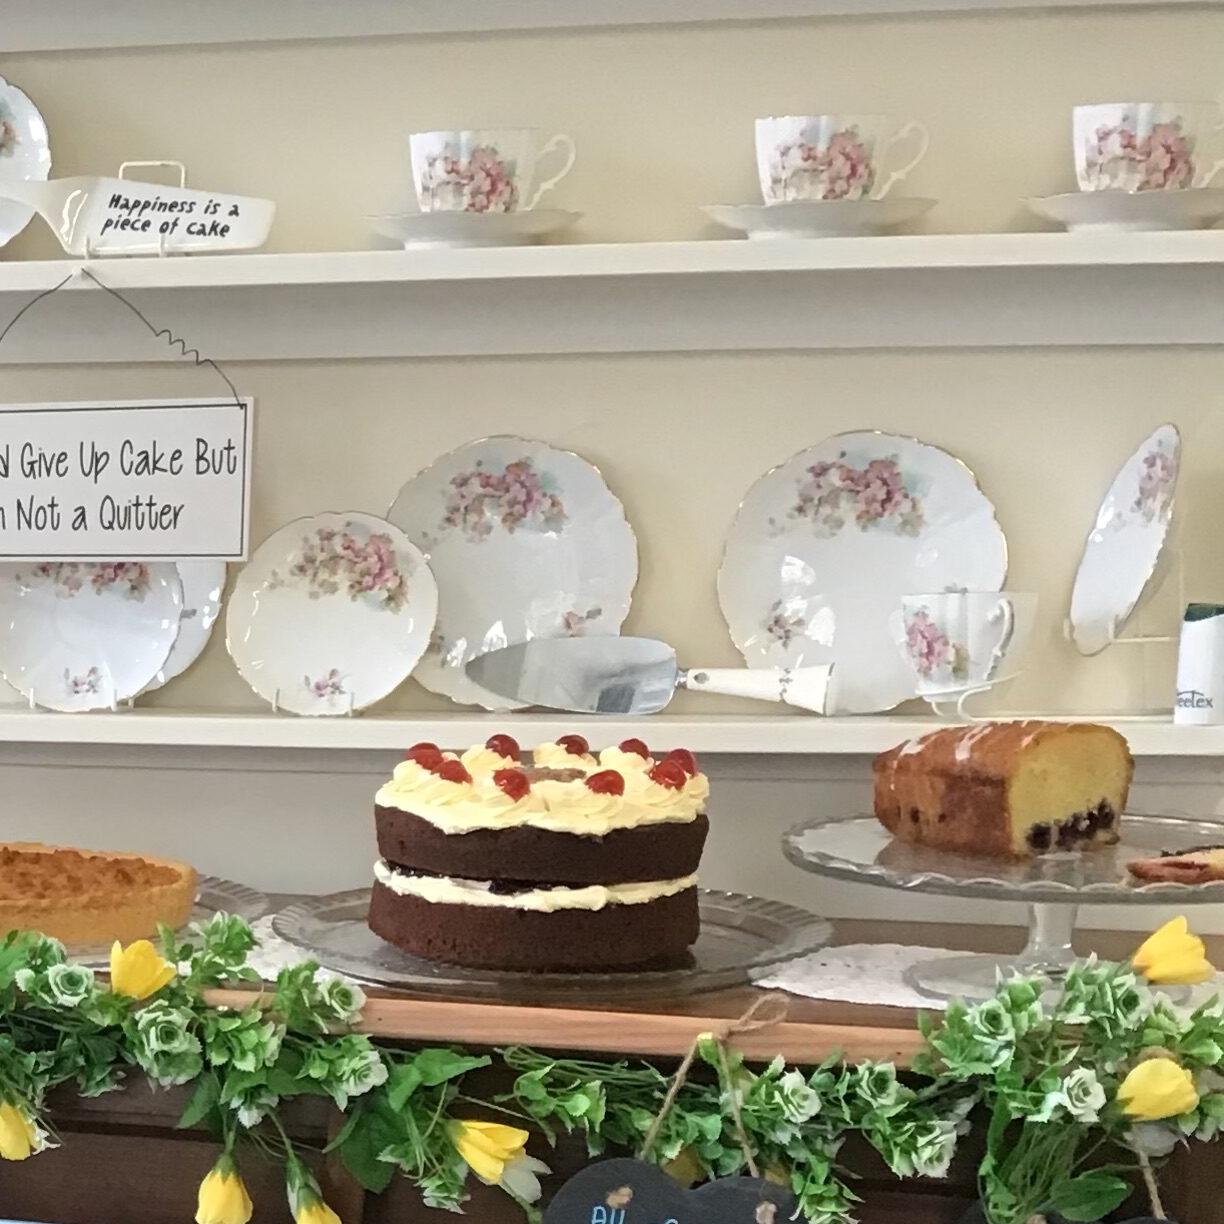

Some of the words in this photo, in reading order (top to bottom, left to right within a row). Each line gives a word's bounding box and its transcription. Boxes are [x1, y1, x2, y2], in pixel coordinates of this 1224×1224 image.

[108, 194, 196, 217] Happiness
[204, 199, 221, 215] is
[228, 204, 240, 217] a
[100, 215, 151, 236] piece
[159, 217, 180, 235] of
[186, 220, 230, 237] cake
[20, 442, 69, 480] Give
[80, 441, 110, 484] Up
[120, 439, 184, 476] Cake
[195, 438, 237, 476] But
[16, 495, 61, 531] Not
[71, 504, 88, 531] a
[99, 495, 185, 531] Quitter
